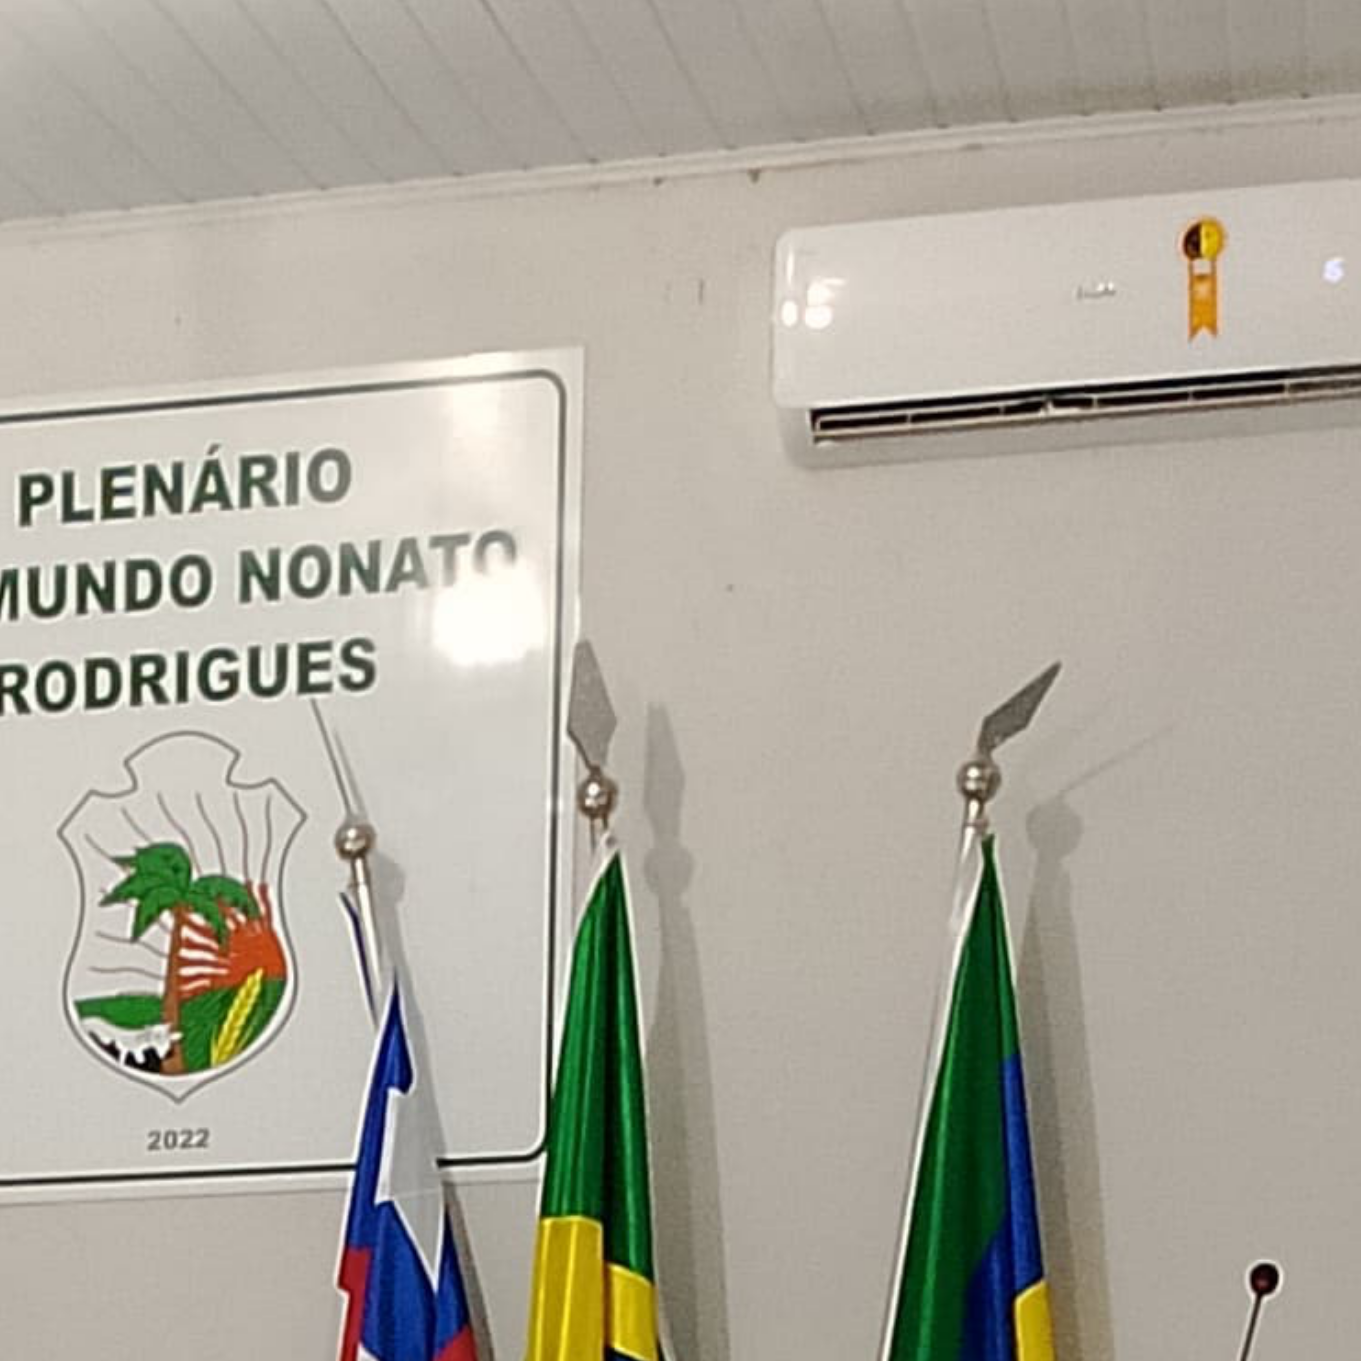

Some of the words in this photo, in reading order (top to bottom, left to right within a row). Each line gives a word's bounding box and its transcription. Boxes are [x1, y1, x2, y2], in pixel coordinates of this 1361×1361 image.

[18, 445, 351, 527] PLENÁRIO
[239, 529, 518, 604] NONATO
[146, 1127, 211, 1152] 2022
